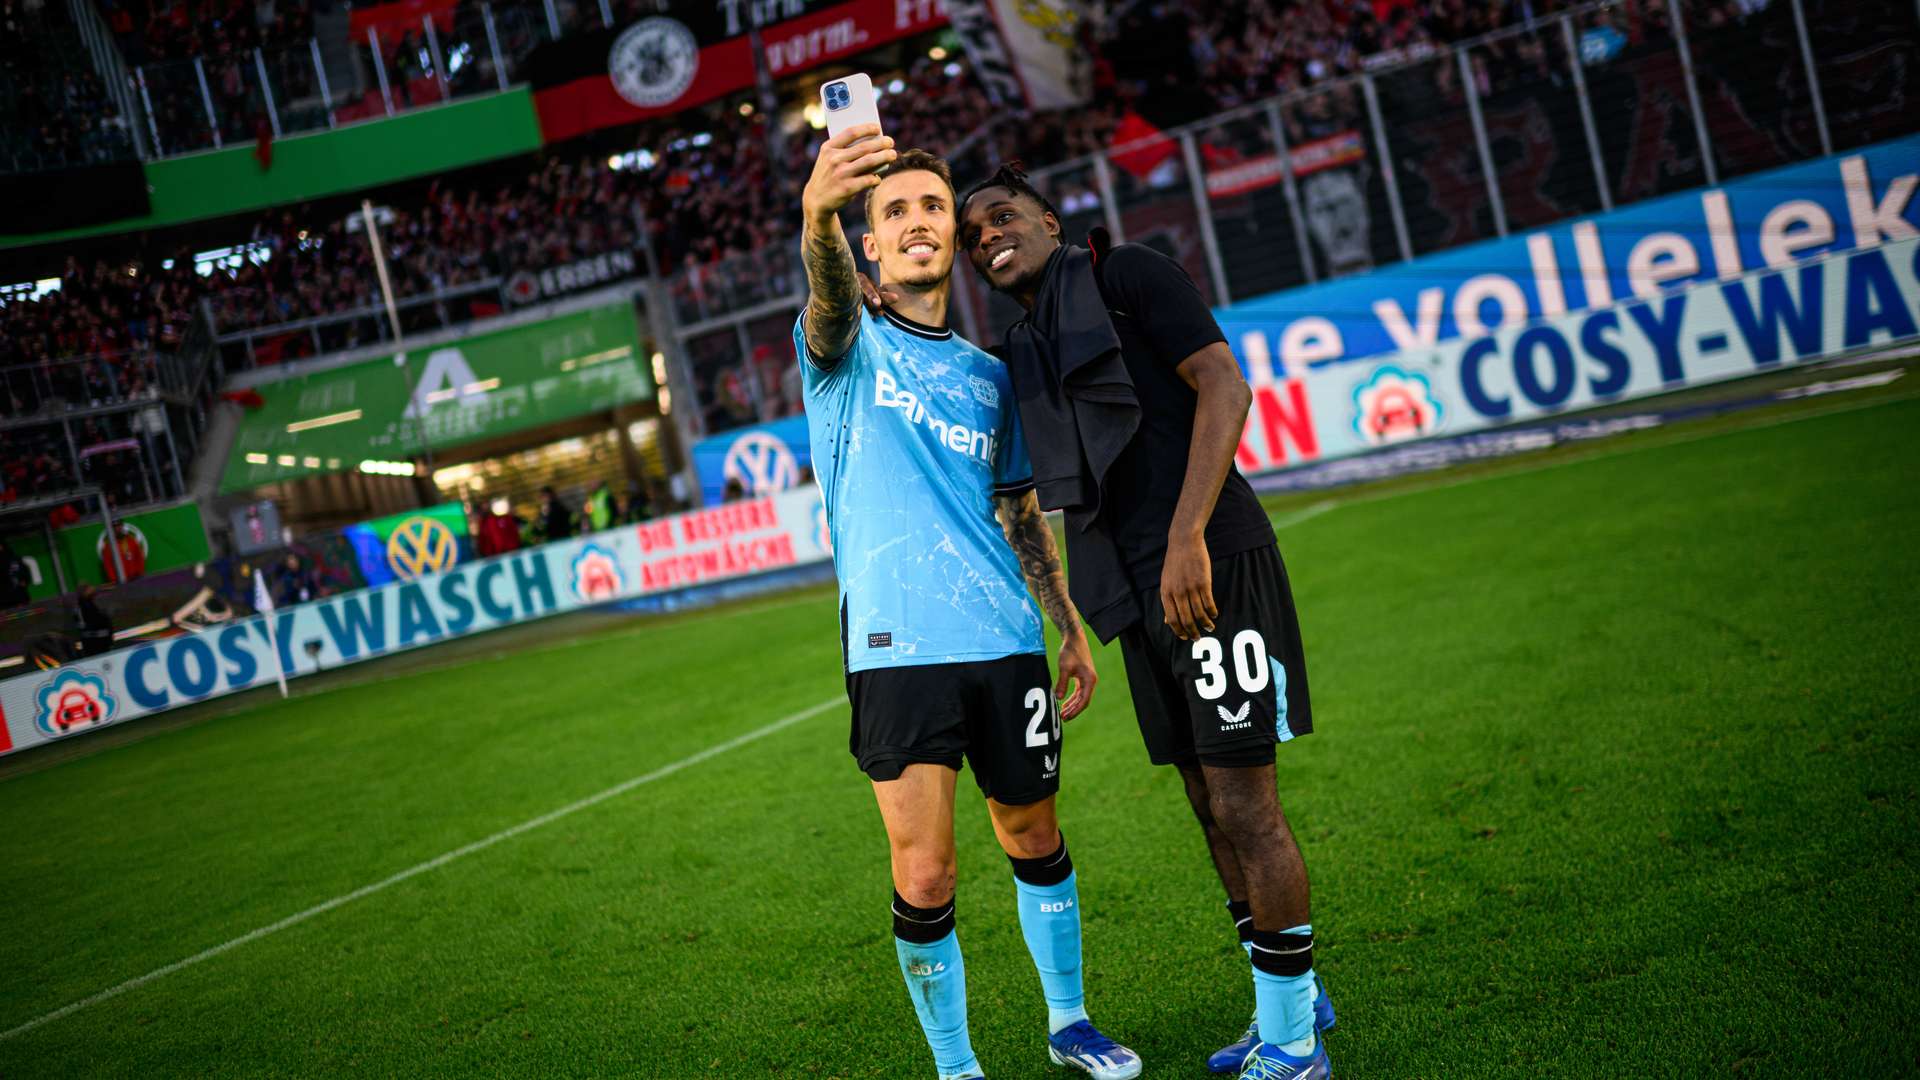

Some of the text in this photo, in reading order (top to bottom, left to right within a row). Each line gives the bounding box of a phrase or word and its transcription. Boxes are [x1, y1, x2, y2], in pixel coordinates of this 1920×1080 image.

[767, 17, 870, 73] vorm.
[1460, 240, 1920, 418] COSY-WA
[637, 519, 676, 553] DIE
[1192, 629, 1269, 700] 30
[1024, 686, 1060, 748] 20
[1221, 721, 1252, 732] CASTORE
